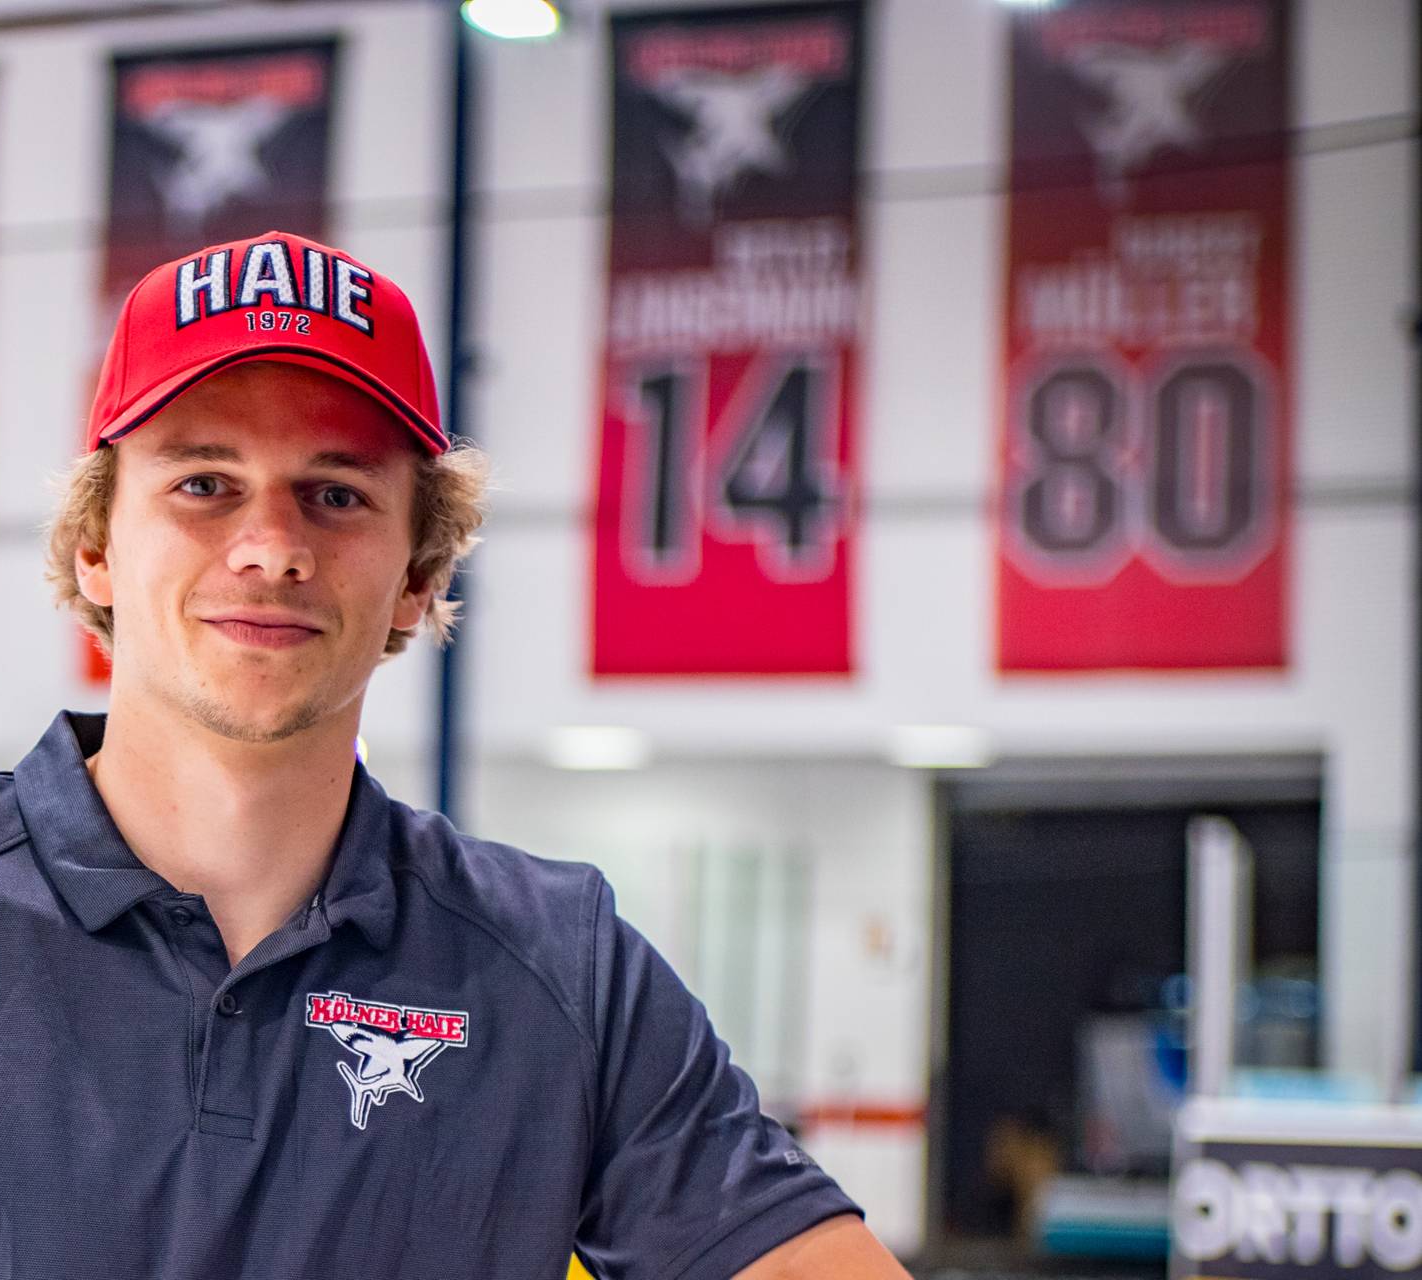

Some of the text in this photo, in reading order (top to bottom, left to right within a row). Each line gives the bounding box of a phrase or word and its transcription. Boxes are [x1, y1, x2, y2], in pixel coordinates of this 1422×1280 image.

[176, 241, 374, 338] HAIE
[246, 311, 310, 334] 1972
[624, 352, 850, 575] 14
[1013, 352, 1270, 574] 80
[311, 995, 465, 1040] KÖLNER HAIE
